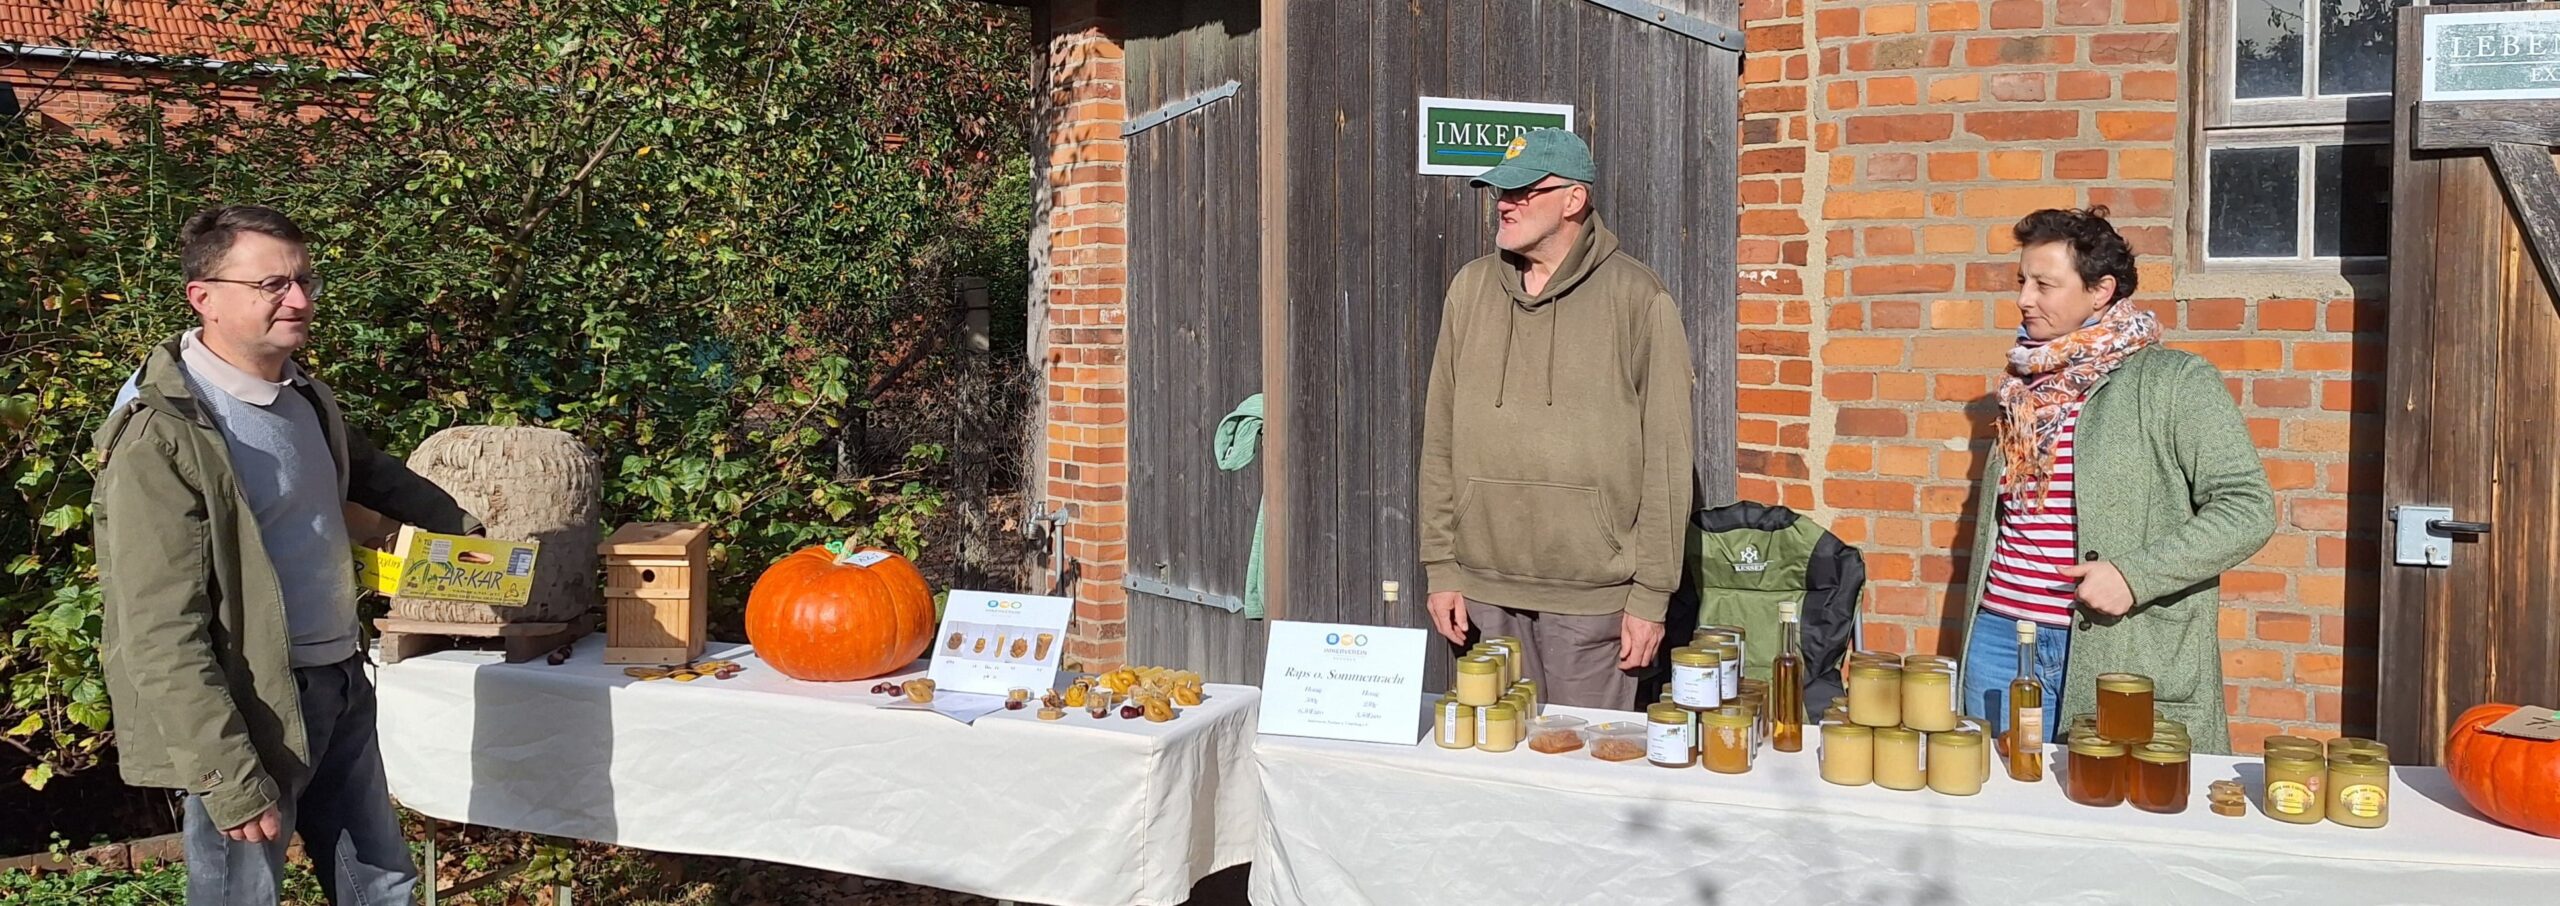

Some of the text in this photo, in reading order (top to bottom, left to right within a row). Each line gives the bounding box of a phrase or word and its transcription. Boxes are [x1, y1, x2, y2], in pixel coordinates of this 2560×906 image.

[1436, 121, 1546, 147] IMKE
[1284, 666, 1311, 681] Raps
[1326, 669, 1405, 685] Sommertracht
